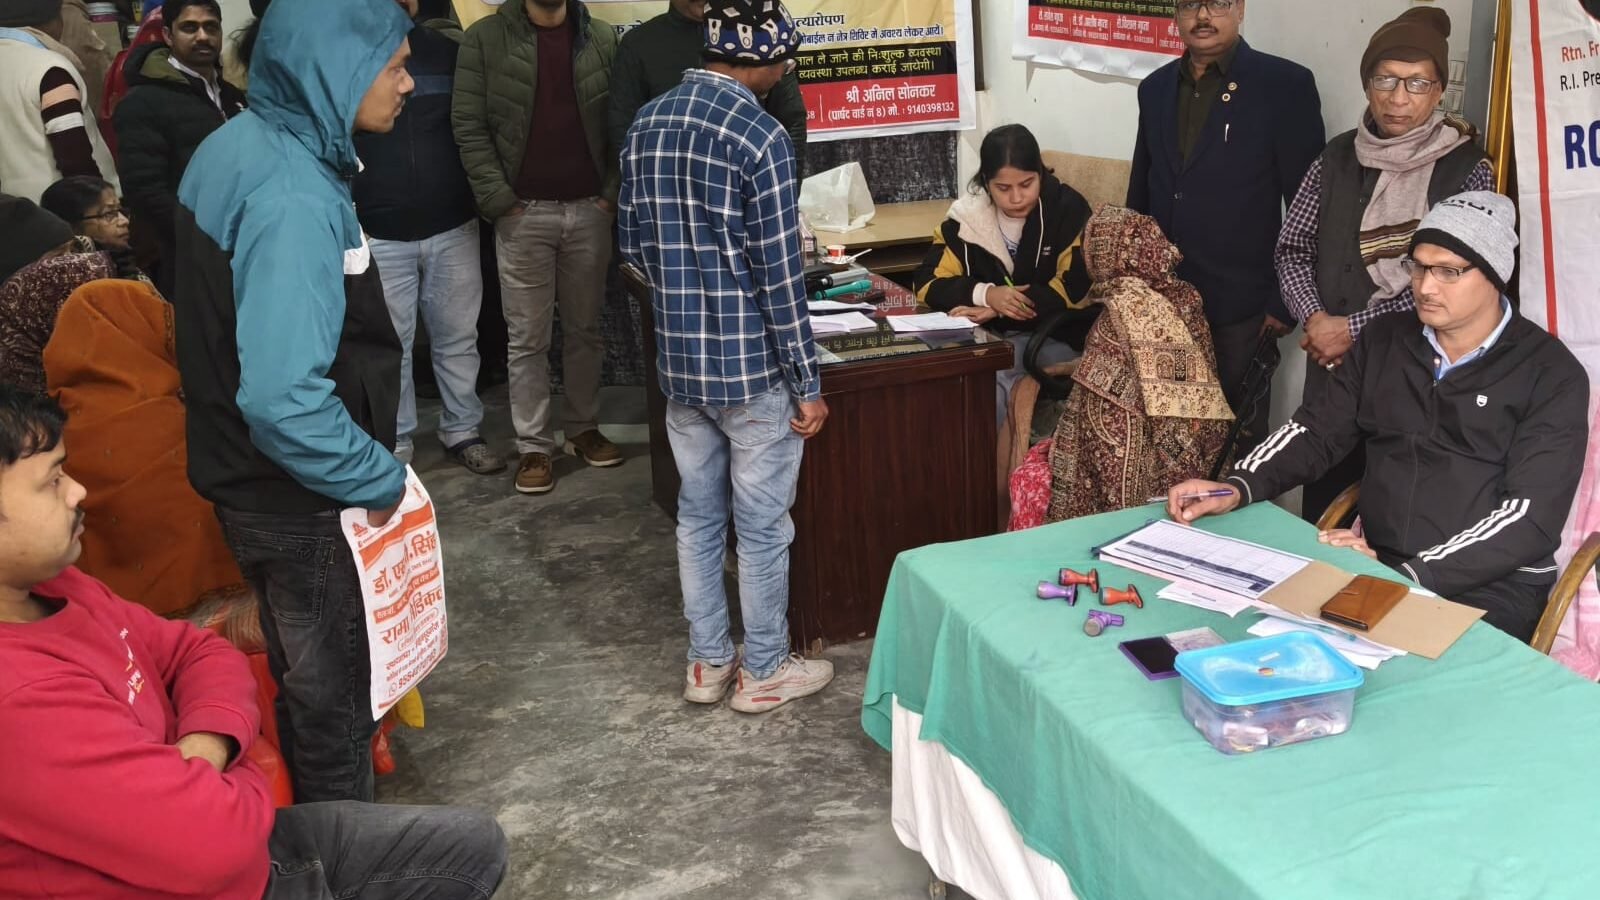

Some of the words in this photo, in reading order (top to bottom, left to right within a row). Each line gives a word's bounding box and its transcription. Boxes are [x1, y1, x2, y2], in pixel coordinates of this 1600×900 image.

[793, 13, 845, 27] त्यारोपण
[850, 28, 869, 41] शिविर
[880, 28, 902, 39] अवश्य
[904, 26, 924, 38] लेकर
[818, 52, 826, 65] ले
[829, 50, 849, 63] जाने
[852, 48, 864, 61] की
[908, 46, 942, 58] व्यवस्था
[1561, 46, 1586, 62] Rtn.
[798, 68, 832, 79] व्यवस्था
[836, 65, 868, 77] उपलब्ध
[872, 60, 897, 74] कराई
[1560, 73, 1580, 91] R.I.
[846, 85, 860, 103] श्री
[863, 83, 895, 103] अनिल
[897, 82, 937, 101] सोनकर
[852, 105, 865, 119] वार्ड
[876, 106, 887, 118] 8)
[907, 102, 955, 115] 9140398132
